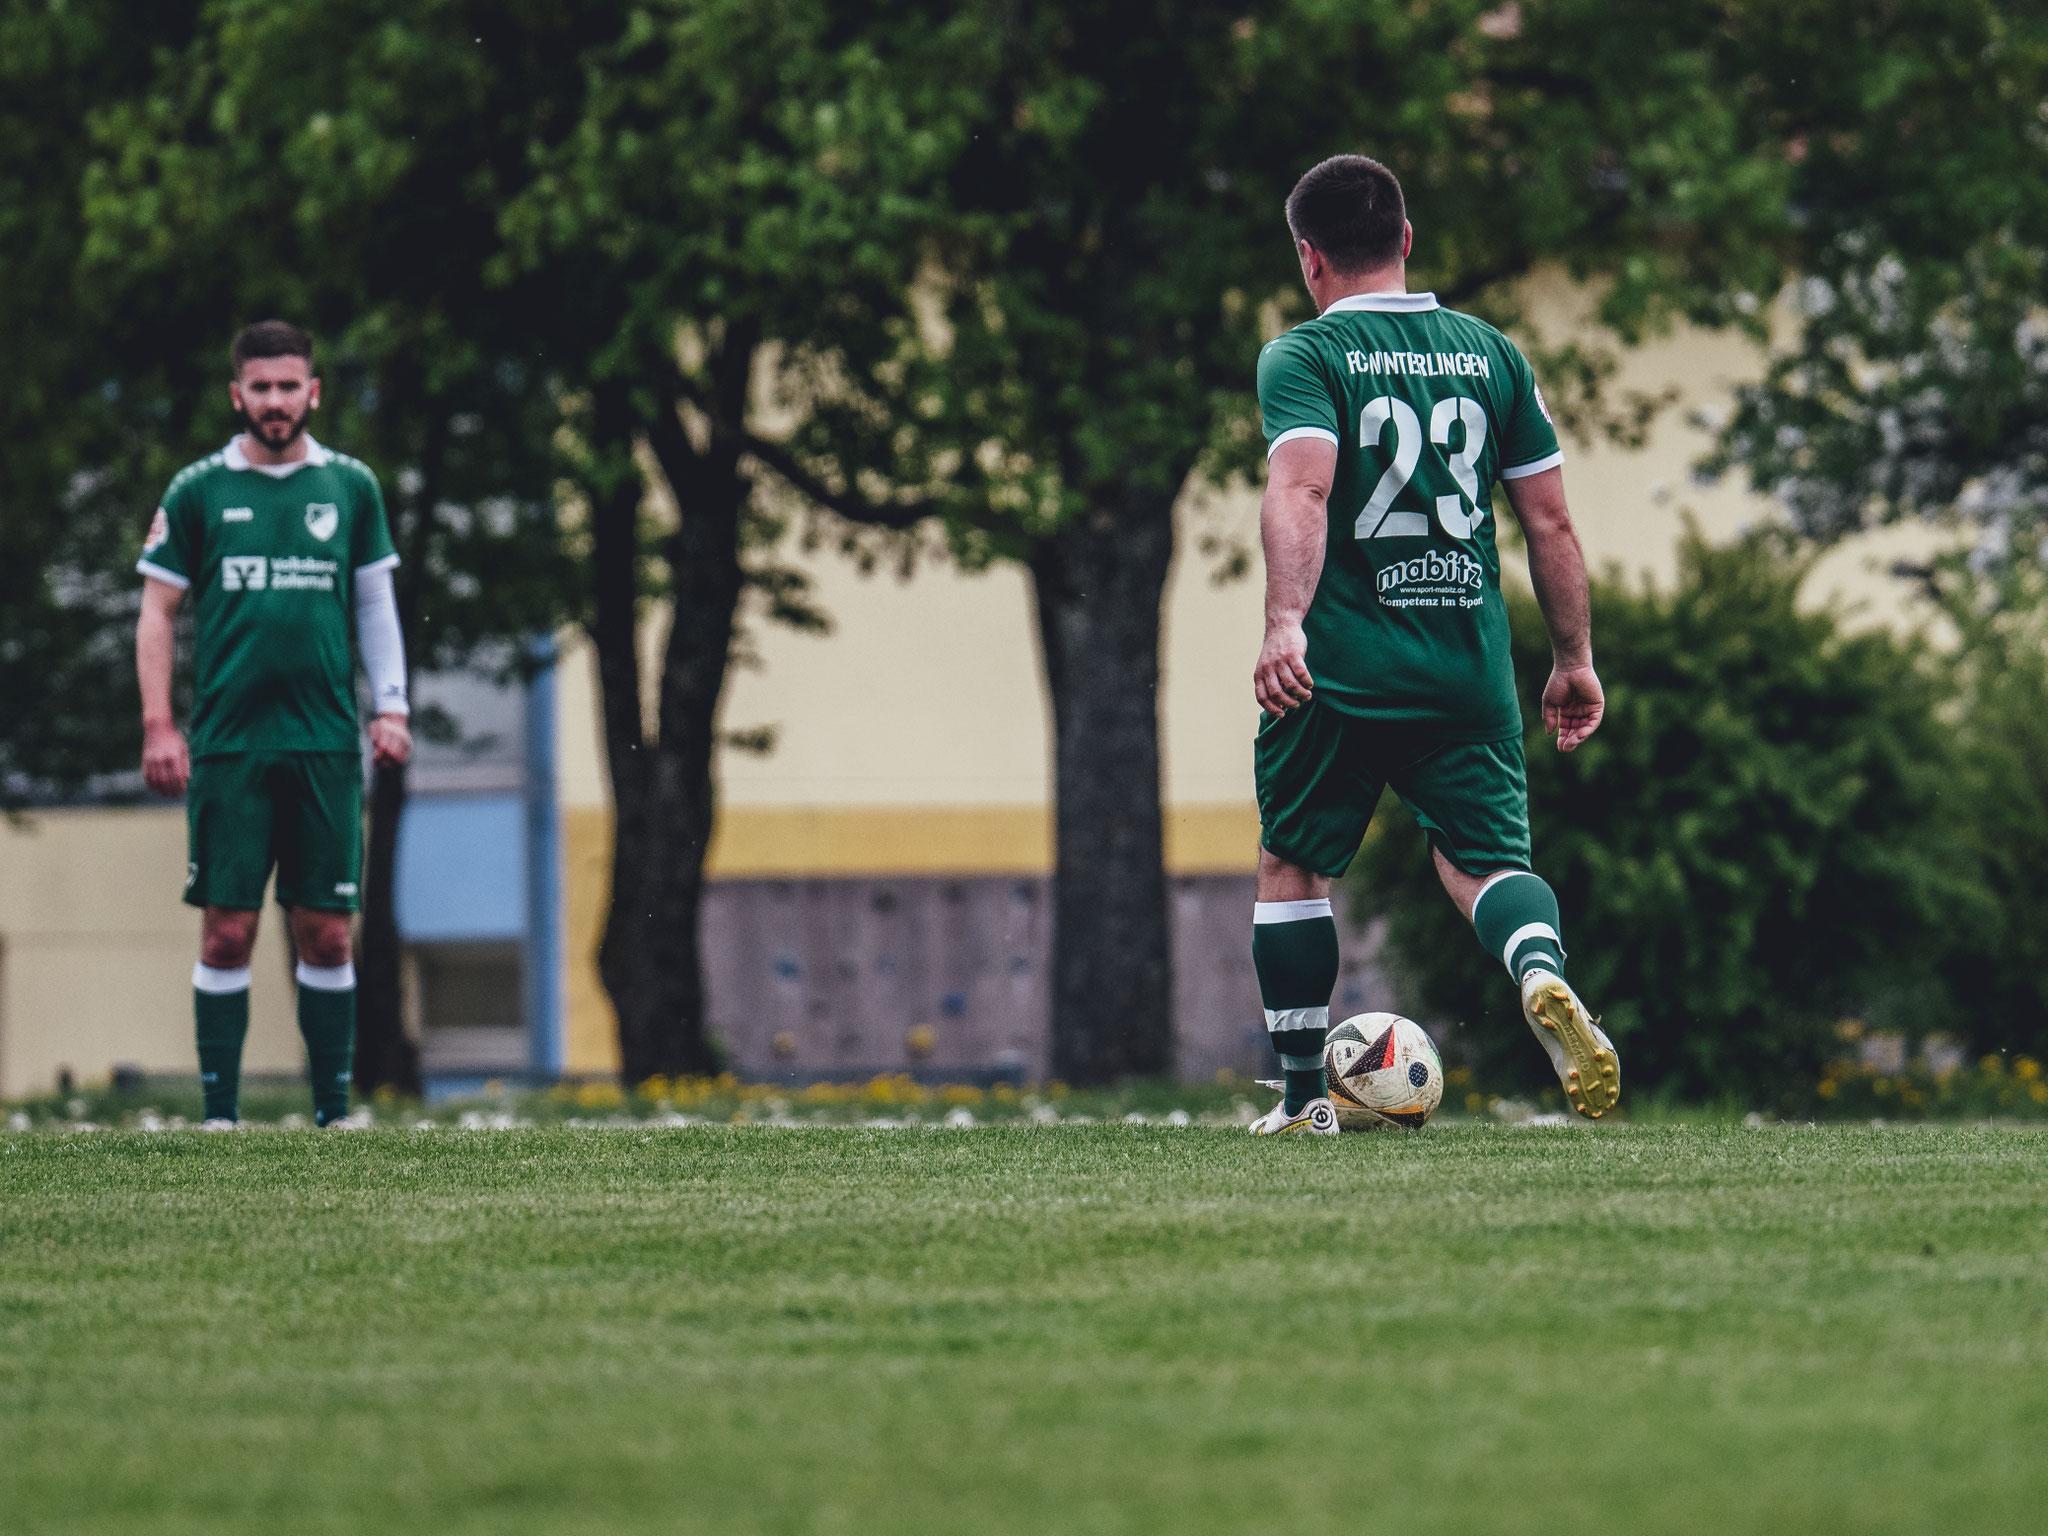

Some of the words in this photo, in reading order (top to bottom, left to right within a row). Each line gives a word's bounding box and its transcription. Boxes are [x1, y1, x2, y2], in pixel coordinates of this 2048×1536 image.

[1355, 395, 1488, 540] 23
[1376, 550, 1483, 593] mabitz
[1378, 595, 1439, 608] Kompetenz
[1441, 596, 1456, 607] im
[1458, 595, 1484, 609] Sport
[1399, 586, 1466, 594] www.sport-mabitz.de
